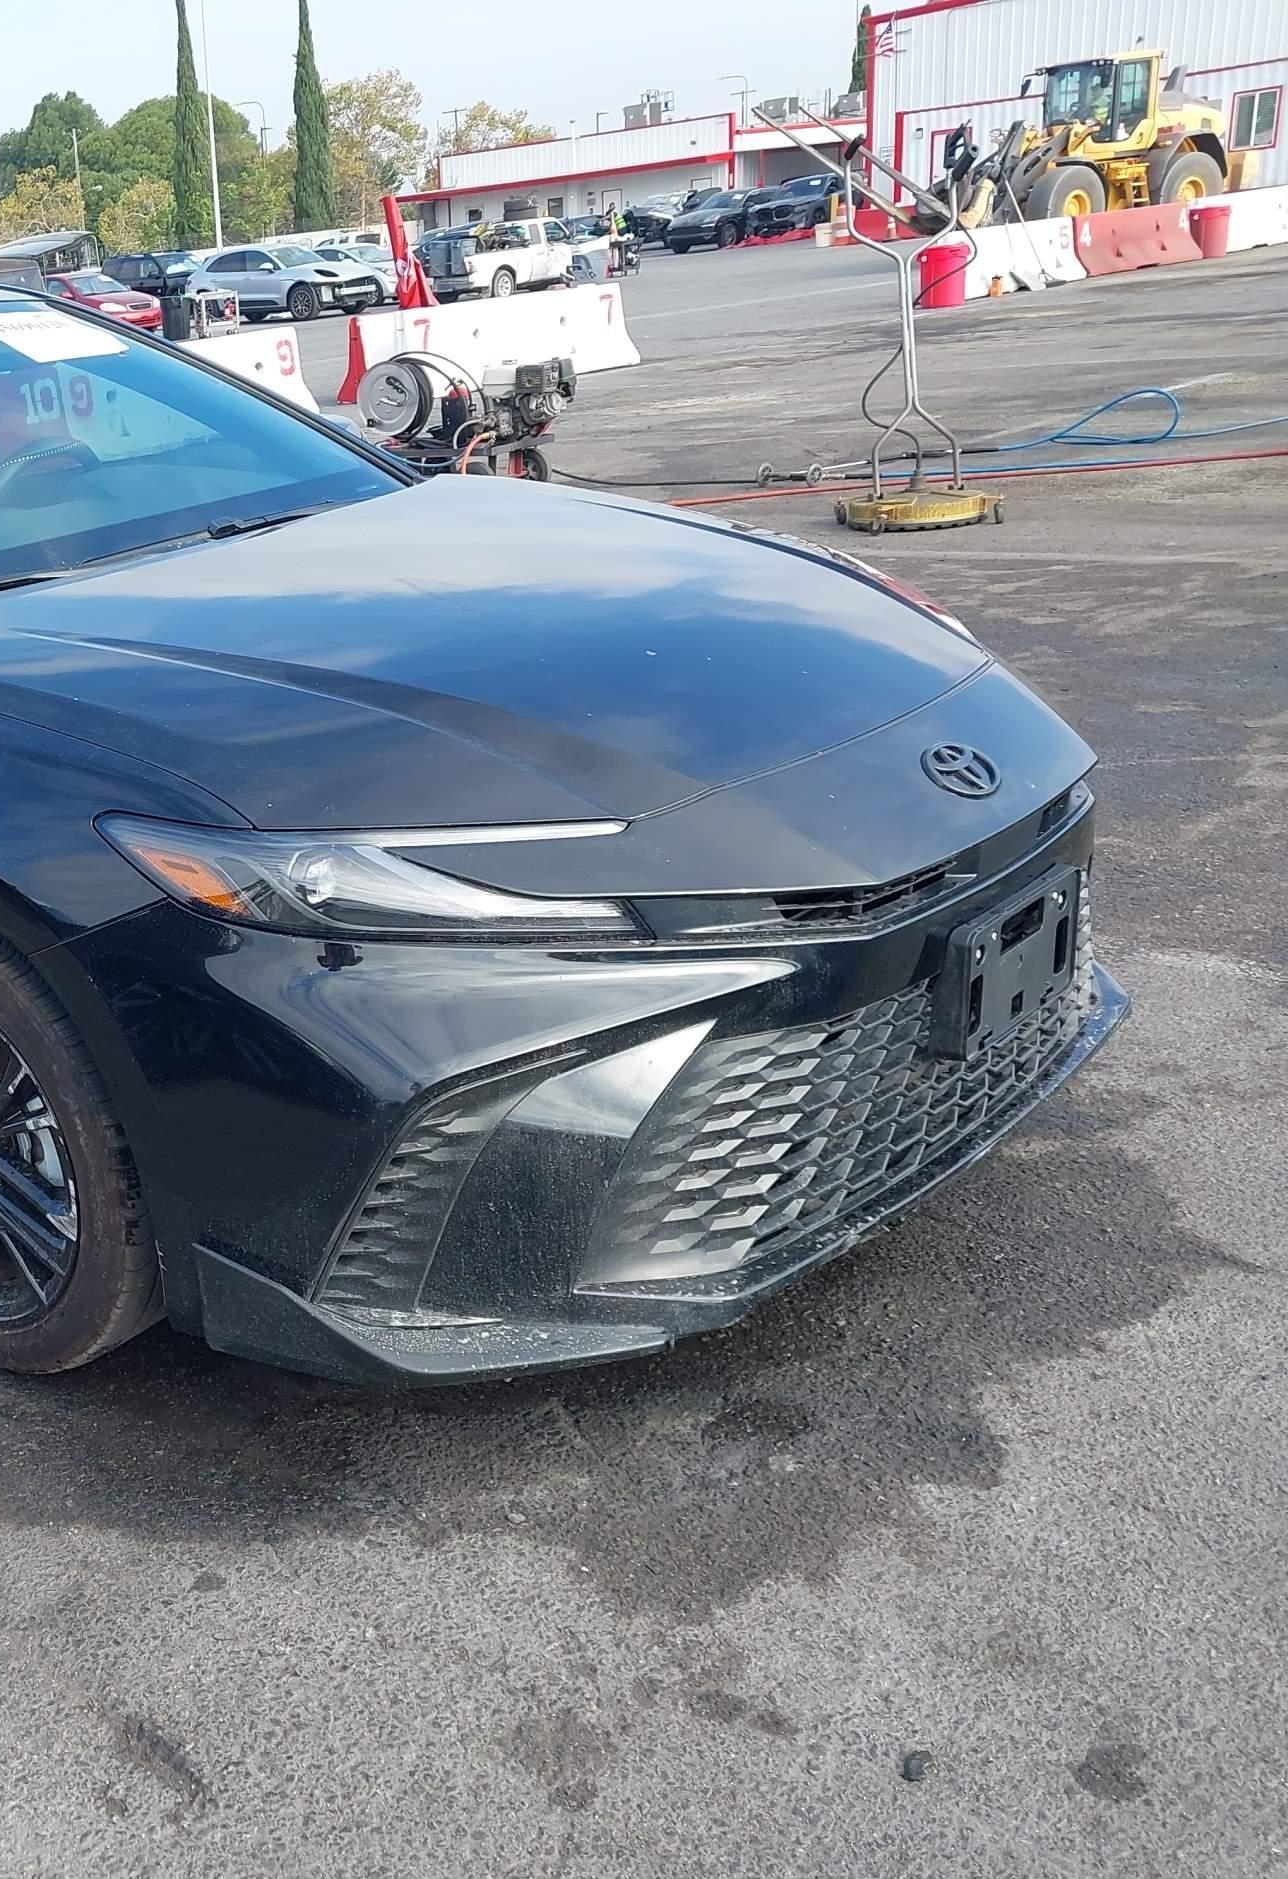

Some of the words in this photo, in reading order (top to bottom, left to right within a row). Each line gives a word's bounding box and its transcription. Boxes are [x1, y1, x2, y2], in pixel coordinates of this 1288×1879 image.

[1079, 221, 1092, 247] 4
[1178, 208, 1188, 233] 4
[1059, 224, 1070, 249] 5
[600, 294, 614, 325] 7
[414, 319, 430, 350] 7
[276, 339, 295, 376] 9
[19, 378, 60, 424] 10
[69, 376, 93, 416] 9
